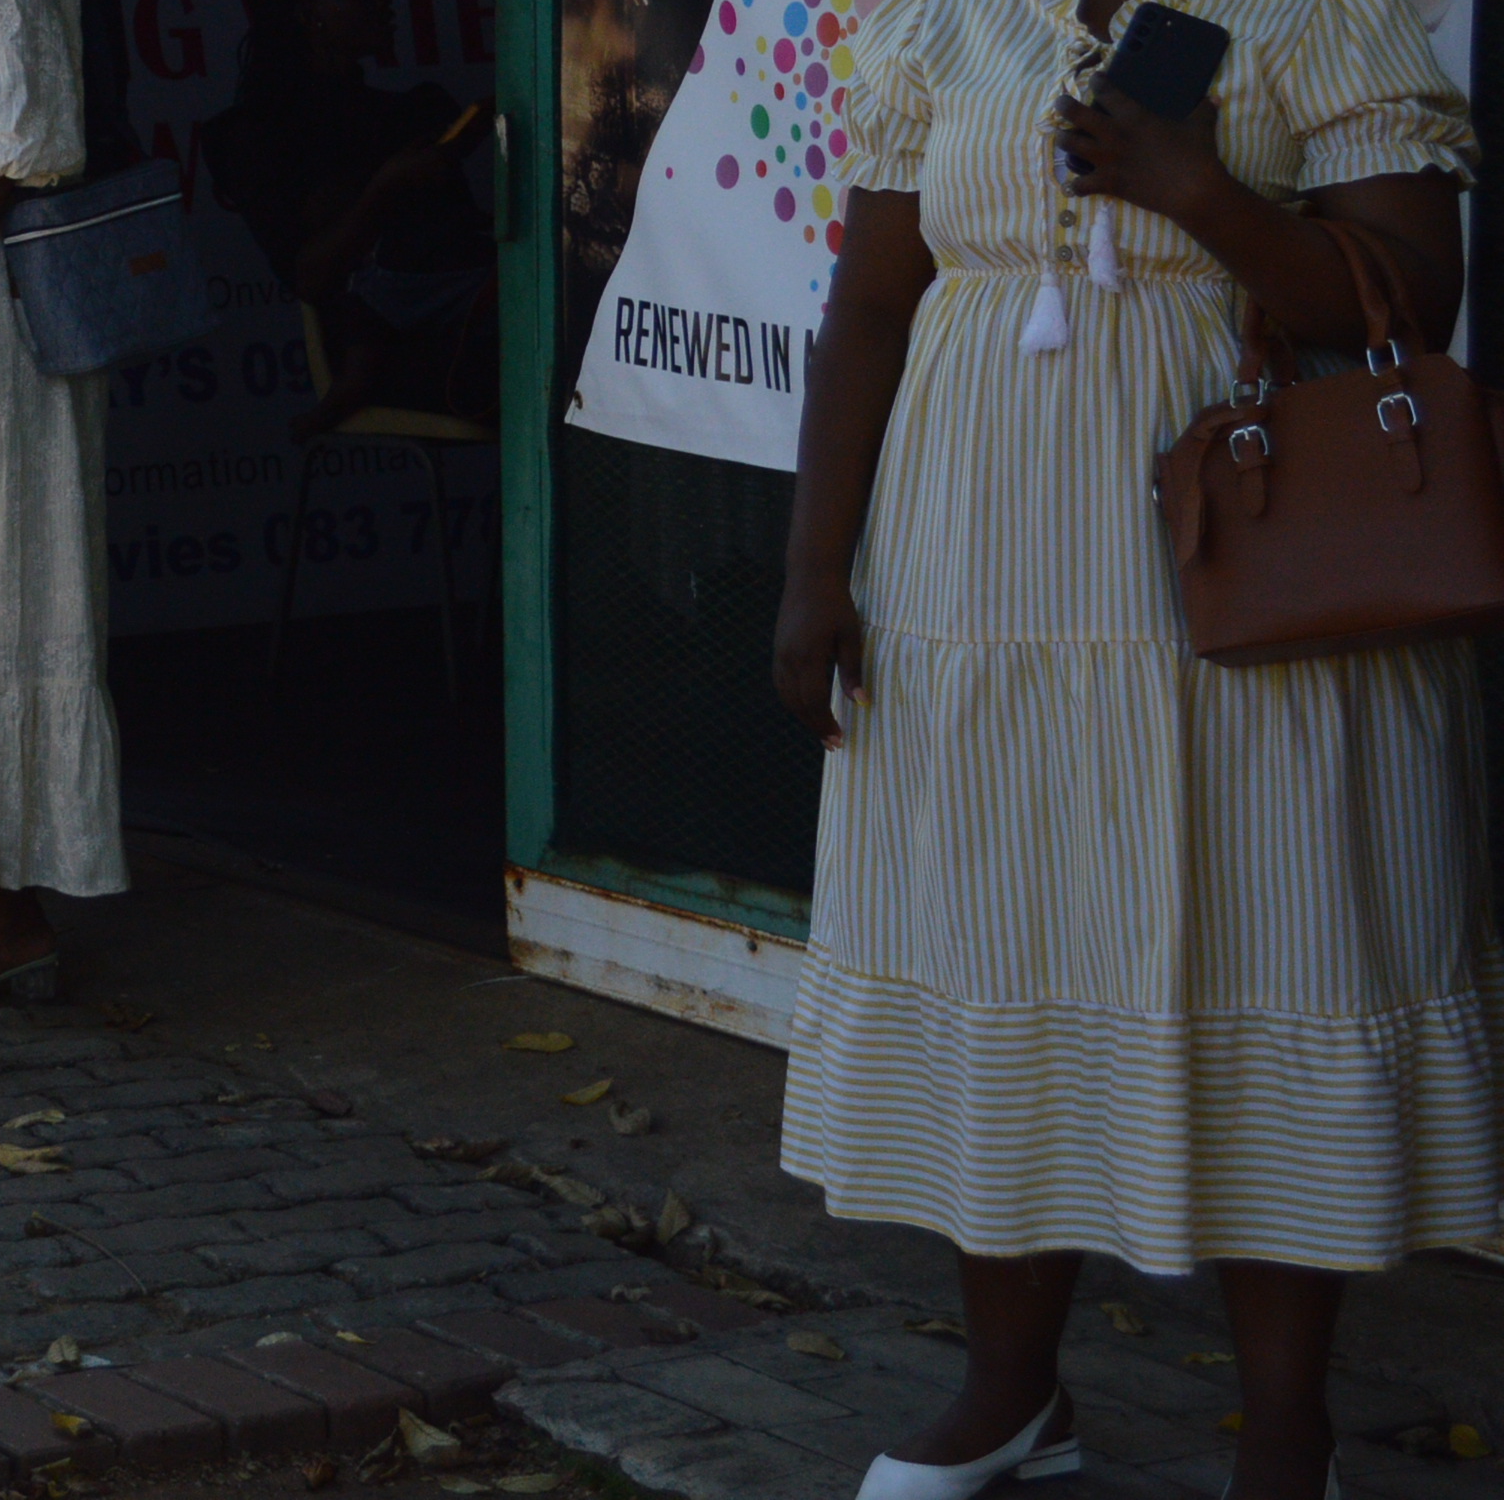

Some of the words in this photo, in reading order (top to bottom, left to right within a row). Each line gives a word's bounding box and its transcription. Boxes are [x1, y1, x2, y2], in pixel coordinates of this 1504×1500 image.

[614, 296, 754, 385] RENEWED
[760, 321, 791, 393] IN
[106, 447, 284, 497] ormation
[110, 525, 242, 583] vies
